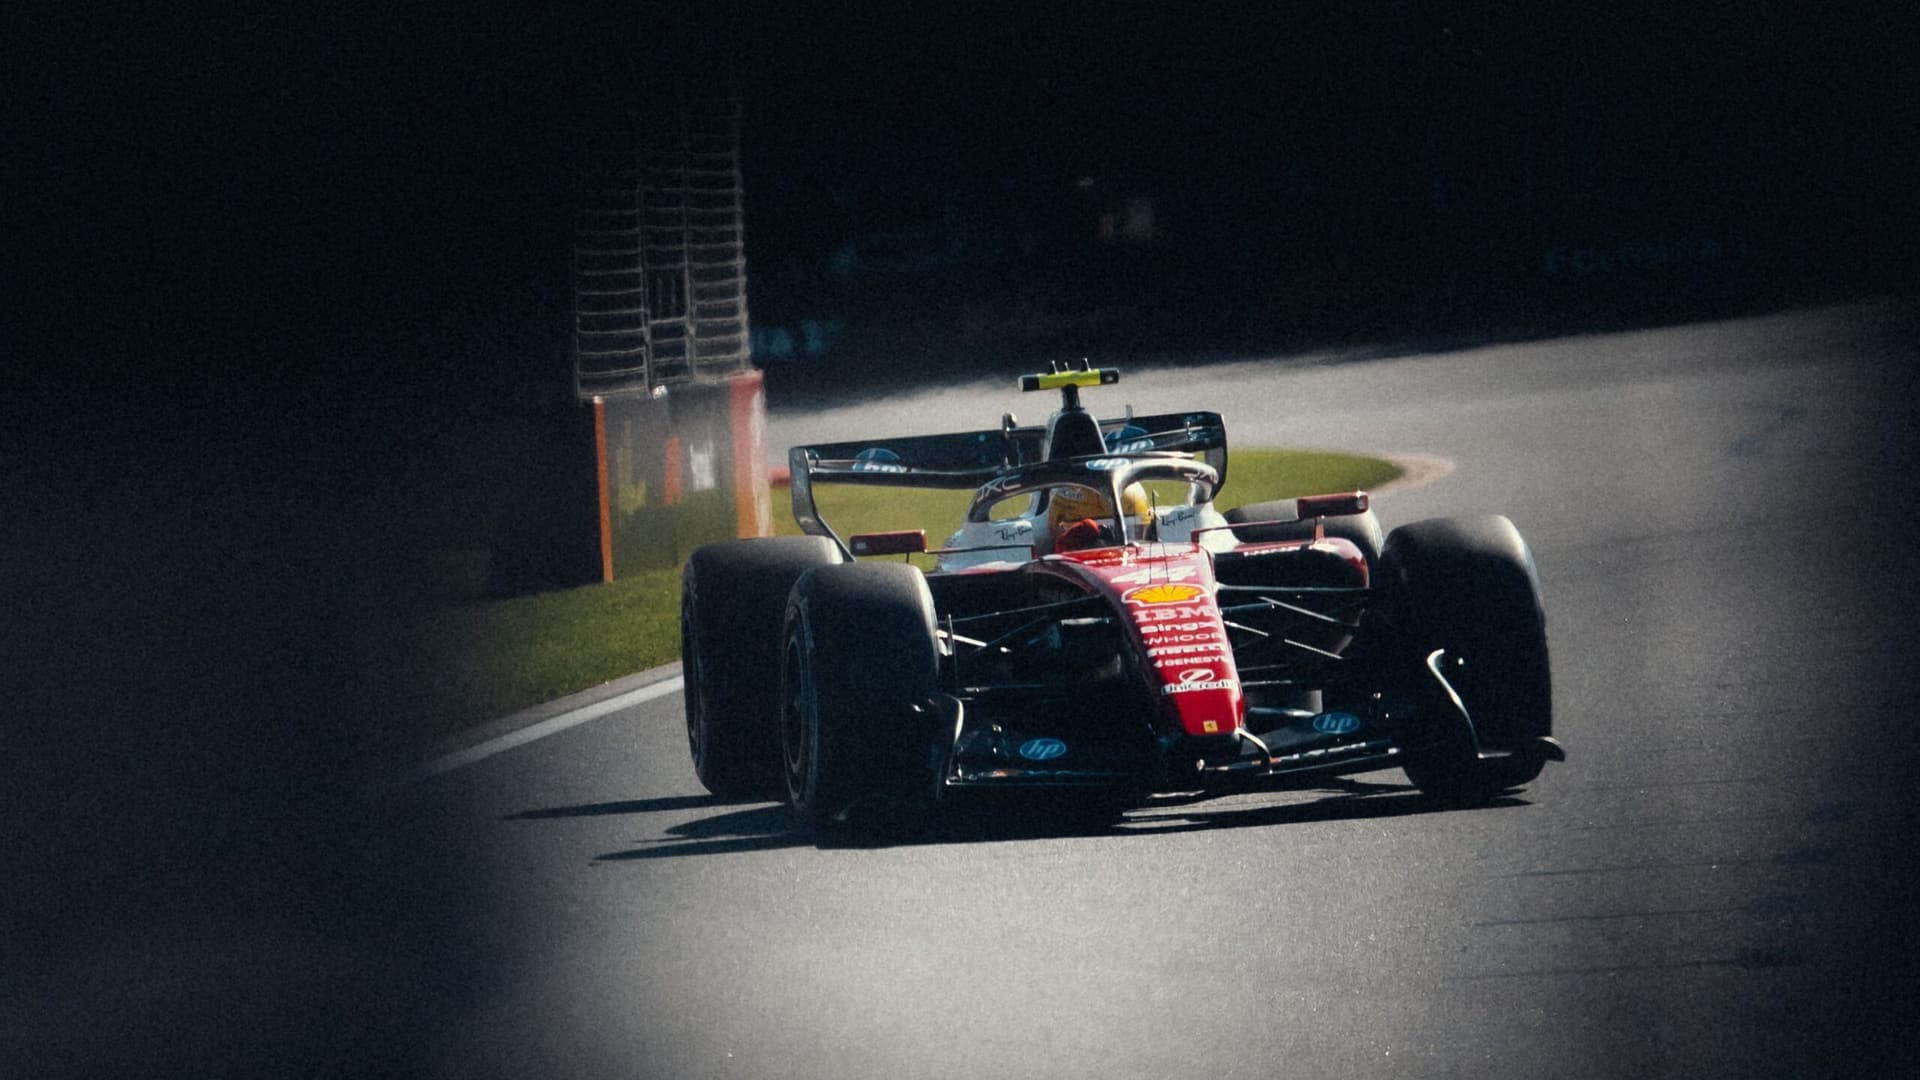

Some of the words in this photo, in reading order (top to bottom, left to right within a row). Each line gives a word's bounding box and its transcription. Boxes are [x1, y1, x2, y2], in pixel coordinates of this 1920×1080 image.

[1133, 606, 1217, 623] IBM
[1313, 713, 1360, 734] hp
[1021, 739, 1065, 759] hp
